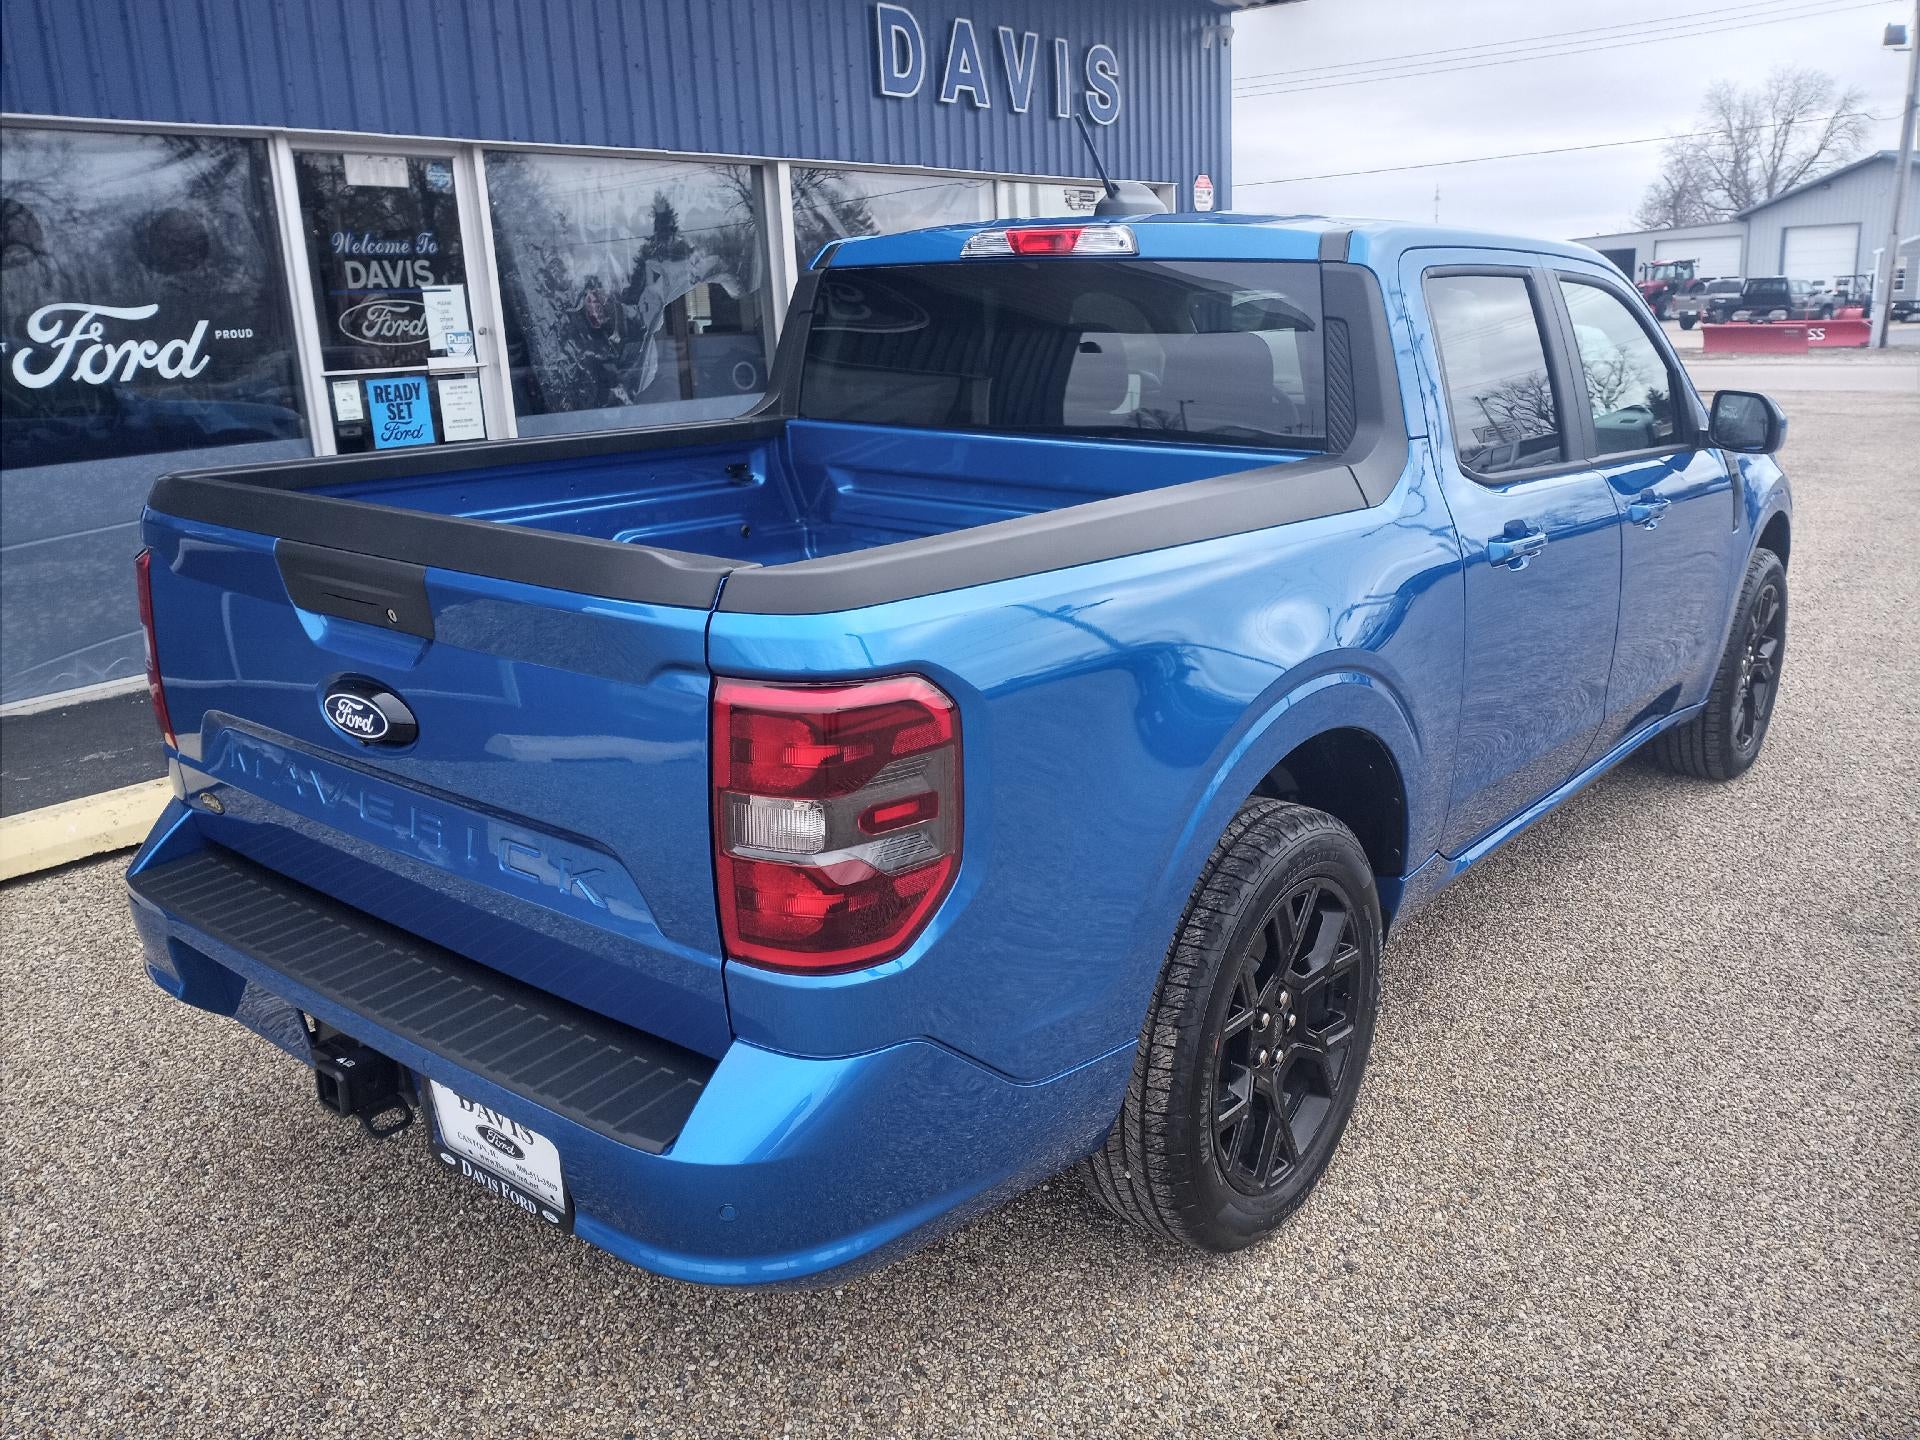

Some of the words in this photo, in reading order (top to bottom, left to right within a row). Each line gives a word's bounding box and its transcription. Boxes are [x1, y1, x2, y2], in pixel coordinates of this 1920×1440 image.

[876, 1, 1122, 127] DAVIS
[331, 230, 410, 255] Welcome
[415, 231, 439, 254] To
[344, 259, 436, 290] DAVIS
[361, 303, 428, 338] Ford
[12, 302, 210, 390] Ford
[214, 328, 254, 340] PROUD
[447, 334, 472, 345] Push
[373, 382, 421, 404] READY
[386, 402, 414, 421] SET
[380, 420, 425, 442] Ford
[335, 699, 375, 734] Ford
[229, 742, 607, 909] MAVERICK
[486, 1129, 516, 1157] Ford
[460, 1158, 500, 1194] DAVIS
[501, 1180, 537, 1215] FORD
